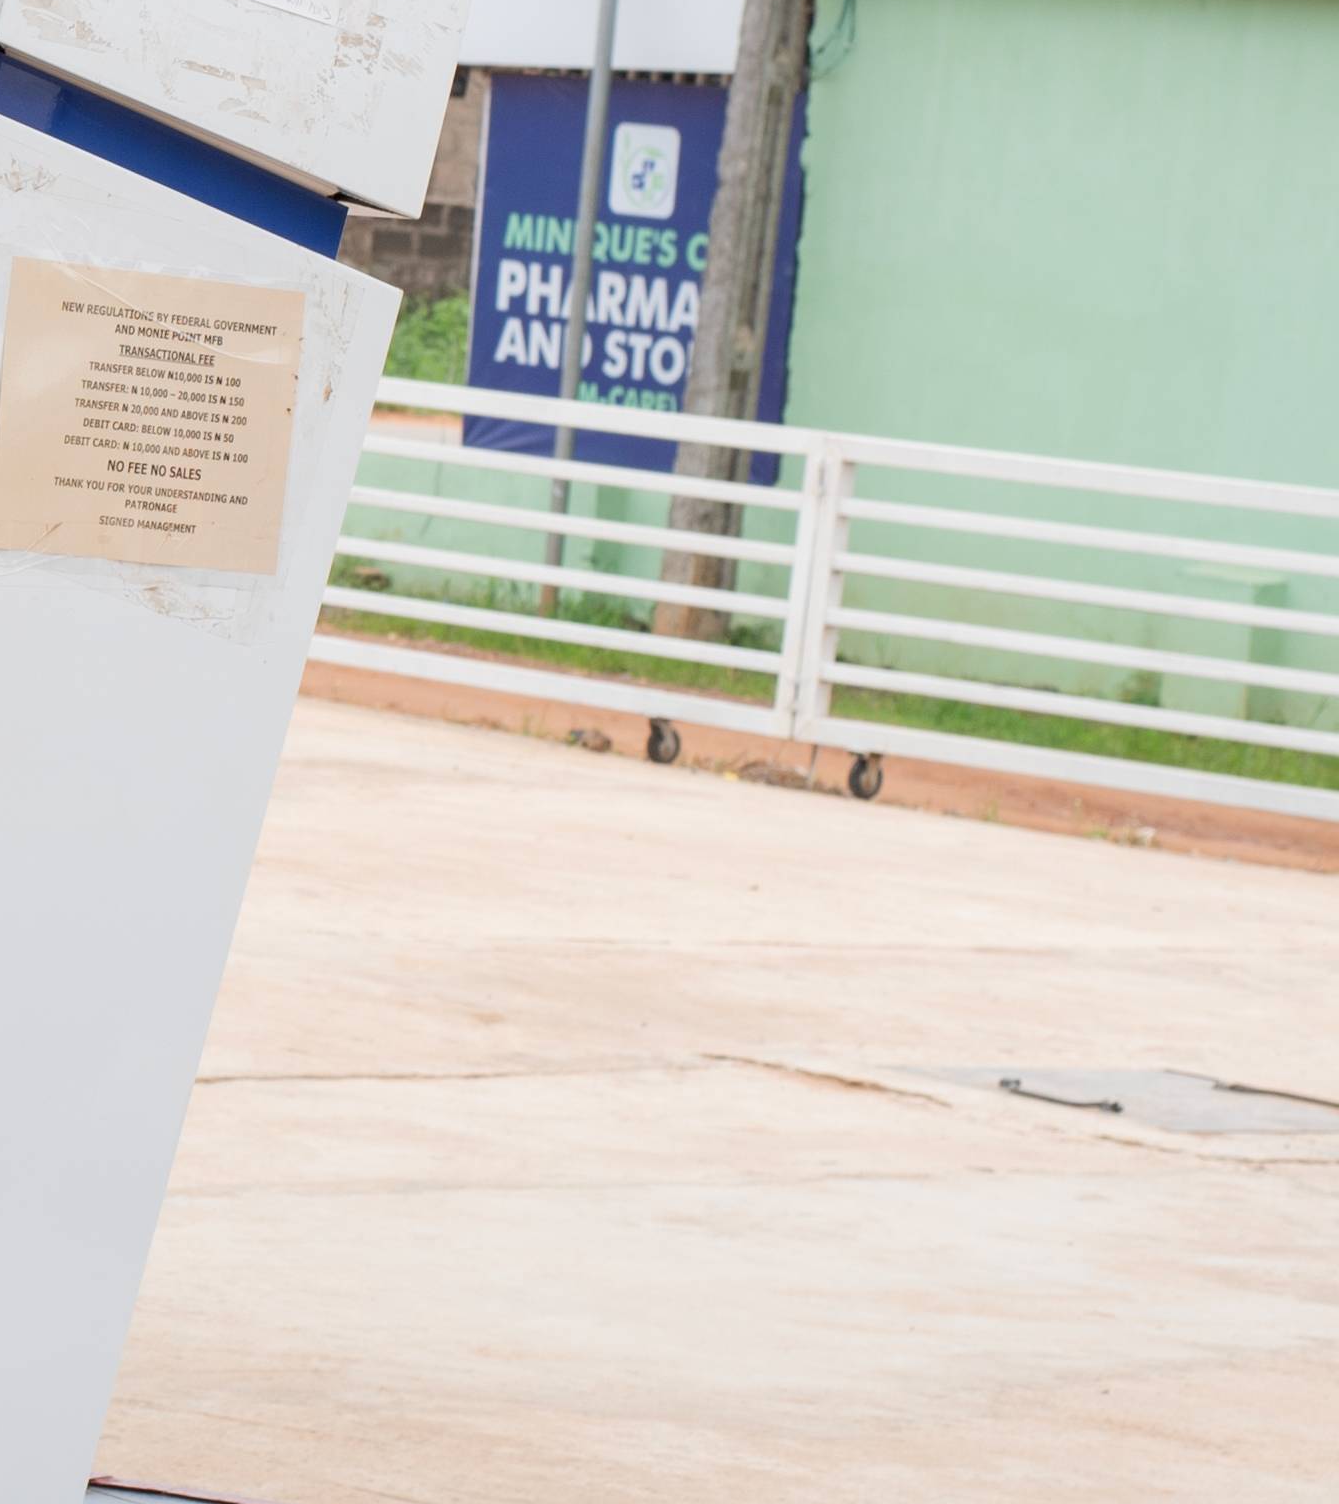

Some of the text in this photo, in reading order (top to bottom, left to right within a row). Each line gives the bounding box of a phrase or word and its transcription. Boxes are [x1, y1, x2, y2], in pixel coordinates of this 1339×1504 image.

[503, 212, 678, 268] MINQUE'S
[61, 301, 276, 335] NEW REGULATIONS BY FEDERAL GOVERNMENT
[114, 323, 223, 345] AND MONIE POINT MFB
[119, 344, 215, 365] TRANSACTIONAL FEE
[601, 329, 692, 386] STO
[89, 361, 133, 374] TRANSFER
[135, 366, 165, 378] BELOW
[204, 374, 214, 384] IS
[225, 377, 241, 387] 100
[81, 379, 128, 393] TRANSFER:
[140, 386, 168, 398] 10,000
[177, 390, 205, 402] 20,000
[207, 393, 217, 404] IS
[228, 396, 244, 406] 150
[75, 397, 119, 411] TRANSFER
[130, 403, 159, 416] 20,000
[160, 407, 178, 418] AND
[180, 410, 208, 421] ABOVE
[210, 413, 220, 423] IS
[230, 415, 247, 425] 200
[82, 417, 110, 429] DEBIT
[112, 420, 138, 432] CARD:
[141, 424, 171, 435] BELOW
[173, 428, 201, 439] 10,000
[202, 430, 212, 441] IS
[223, 433, 234, 443] 50
[64, 434, 90, 445] DEBIT
[92, 437, 119, 449] CARD:
[132, 442, 160, 453] 10,000
[161, 445, 180, 456] AND
[181, 447, 209, 459] ABOVE
[211, 450, 221, 460] IS
[232, 453, 248, 463] 100
[107, 459, 201, 480] NO FEE NO SALES
[54, 476, 248, 505] THANK YOU FOR YOUR UNDERSTANDING AND
[124, 498, 176, 513] PATRONAGE
[99, 515, 196, 533] SIGNED MANAGEMENT
